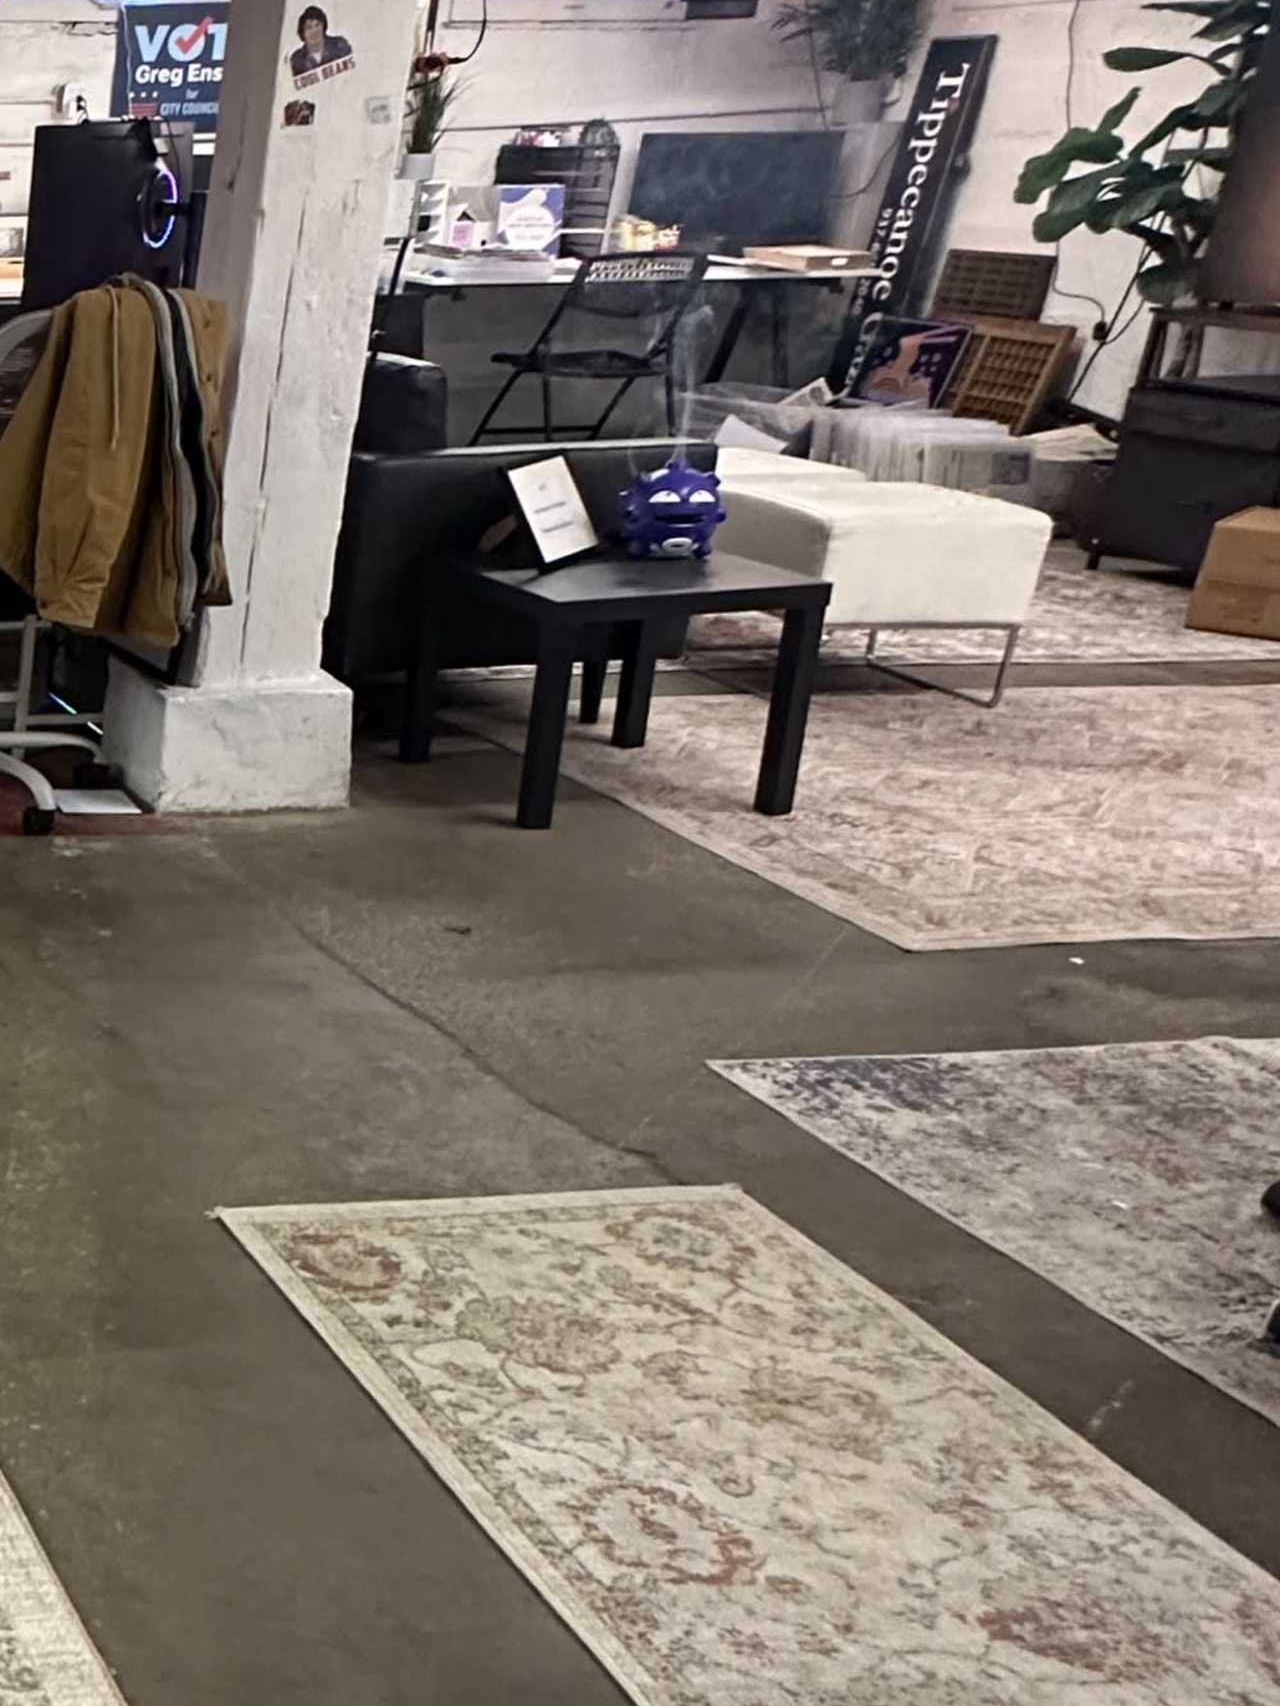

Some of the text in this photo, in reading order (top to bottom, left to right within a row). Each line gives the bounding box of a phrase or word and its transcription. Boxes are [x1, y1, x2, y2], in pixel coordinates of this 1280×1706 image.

[134, 63, 184, 88] Greg
[160, 101, 181, 115] CITY
[873, 62, 971, 302] Tippecanoe
